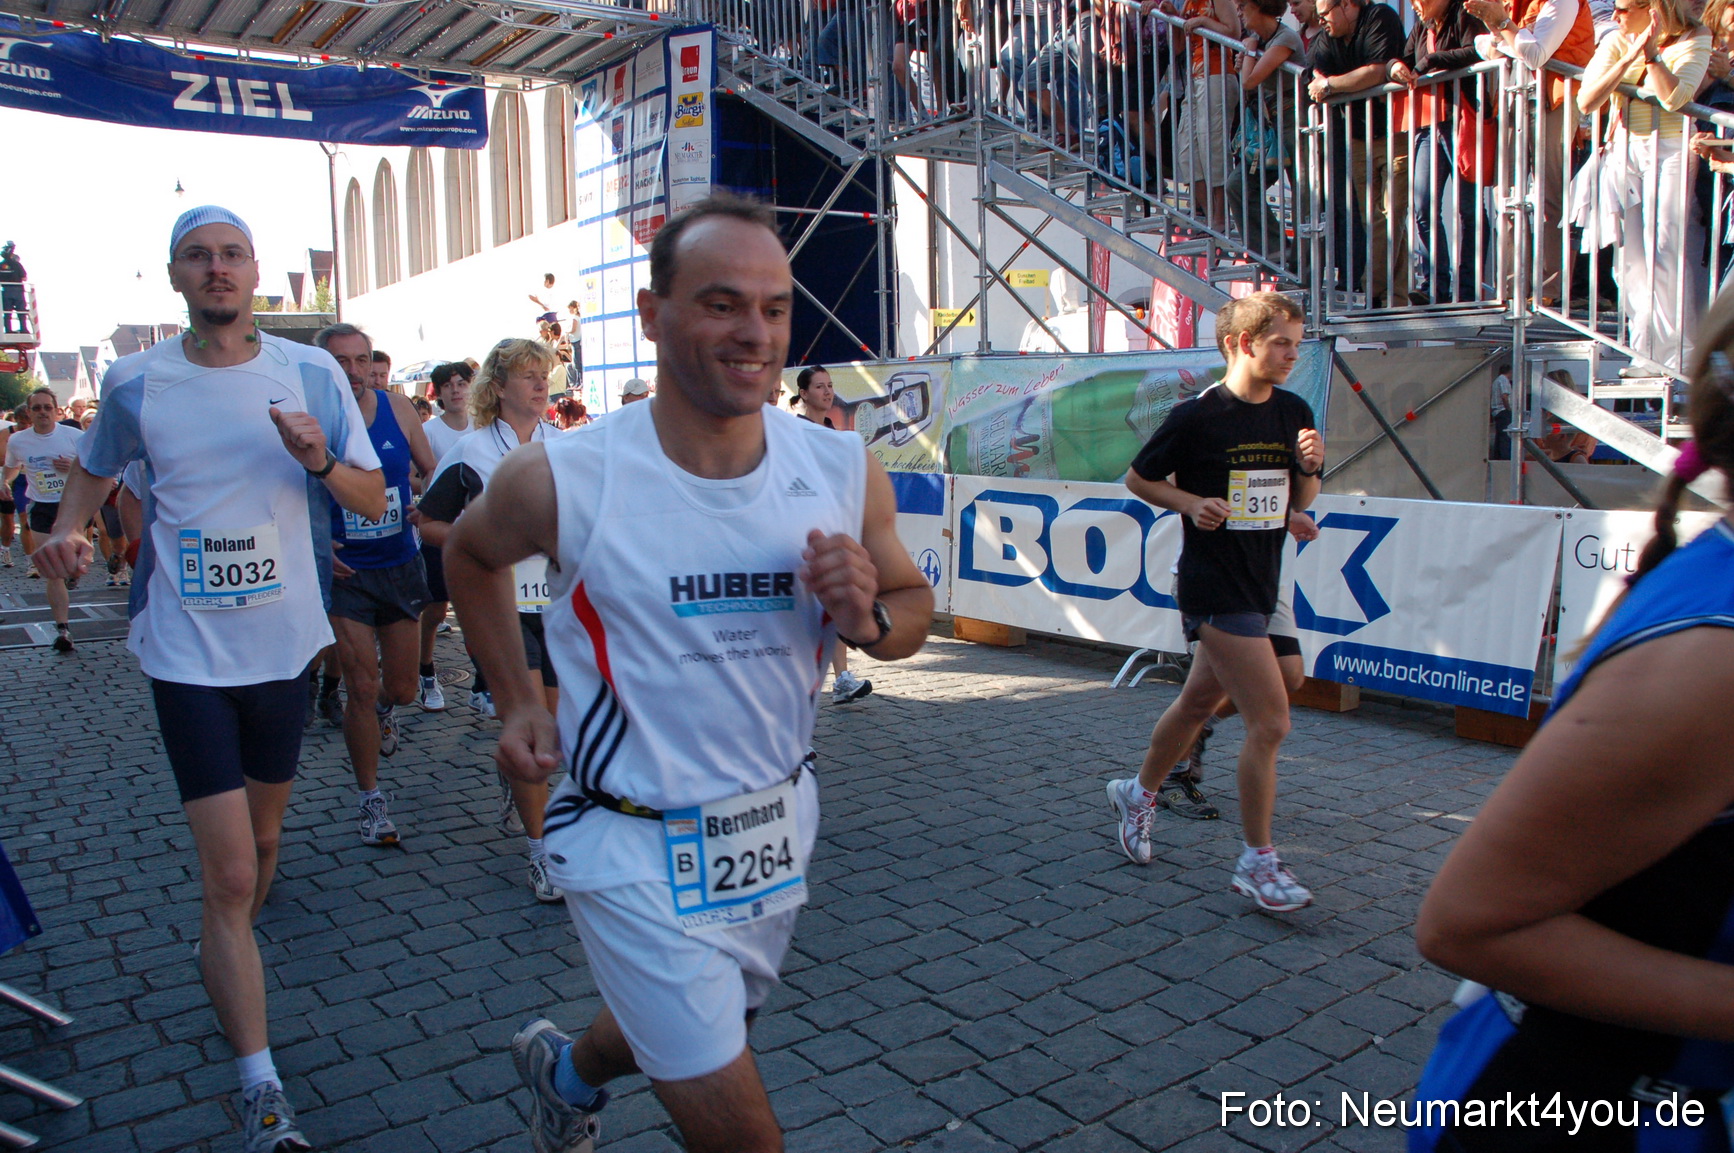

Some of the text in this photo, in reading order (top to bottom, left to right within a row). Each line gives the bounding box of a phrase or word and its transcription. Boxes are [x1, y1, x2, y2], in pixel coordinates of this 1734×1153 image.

[171, 71, 313, 121] ZIEL
[400, 126, 478, 134] www.mizunoeurope.com
[995, 384, 1020, 395] zum
[1023, 363, 1064, 395] Leben
[980, 426, 992, 477] MINERALBR
[1248, 477, 1286, 488] Johannes
[1232, 492, 1241, 502] C
[1248, 495, 1278, 513] 316
[204, 536, 256, 553] Roland
[1574, 534, 1636, 573] Gut
[186, 559, 197, 572] B
[208, 558, 277, 588] 3032
[183, 589, 282, 606] BOCK PFLEIDERER
[670, 572, 795, 603] HUBER
[713, 628, 758, 643] Water
[679, 650, 725, 664] moves
[726, 646, 750, 660] the
[1332, 652, 1526, 703] www.bockonline.de
[705, 796, 787, 838] Bernhard
[677, 852, 694, 874] B
[712, 836, 794, 893] 2264
